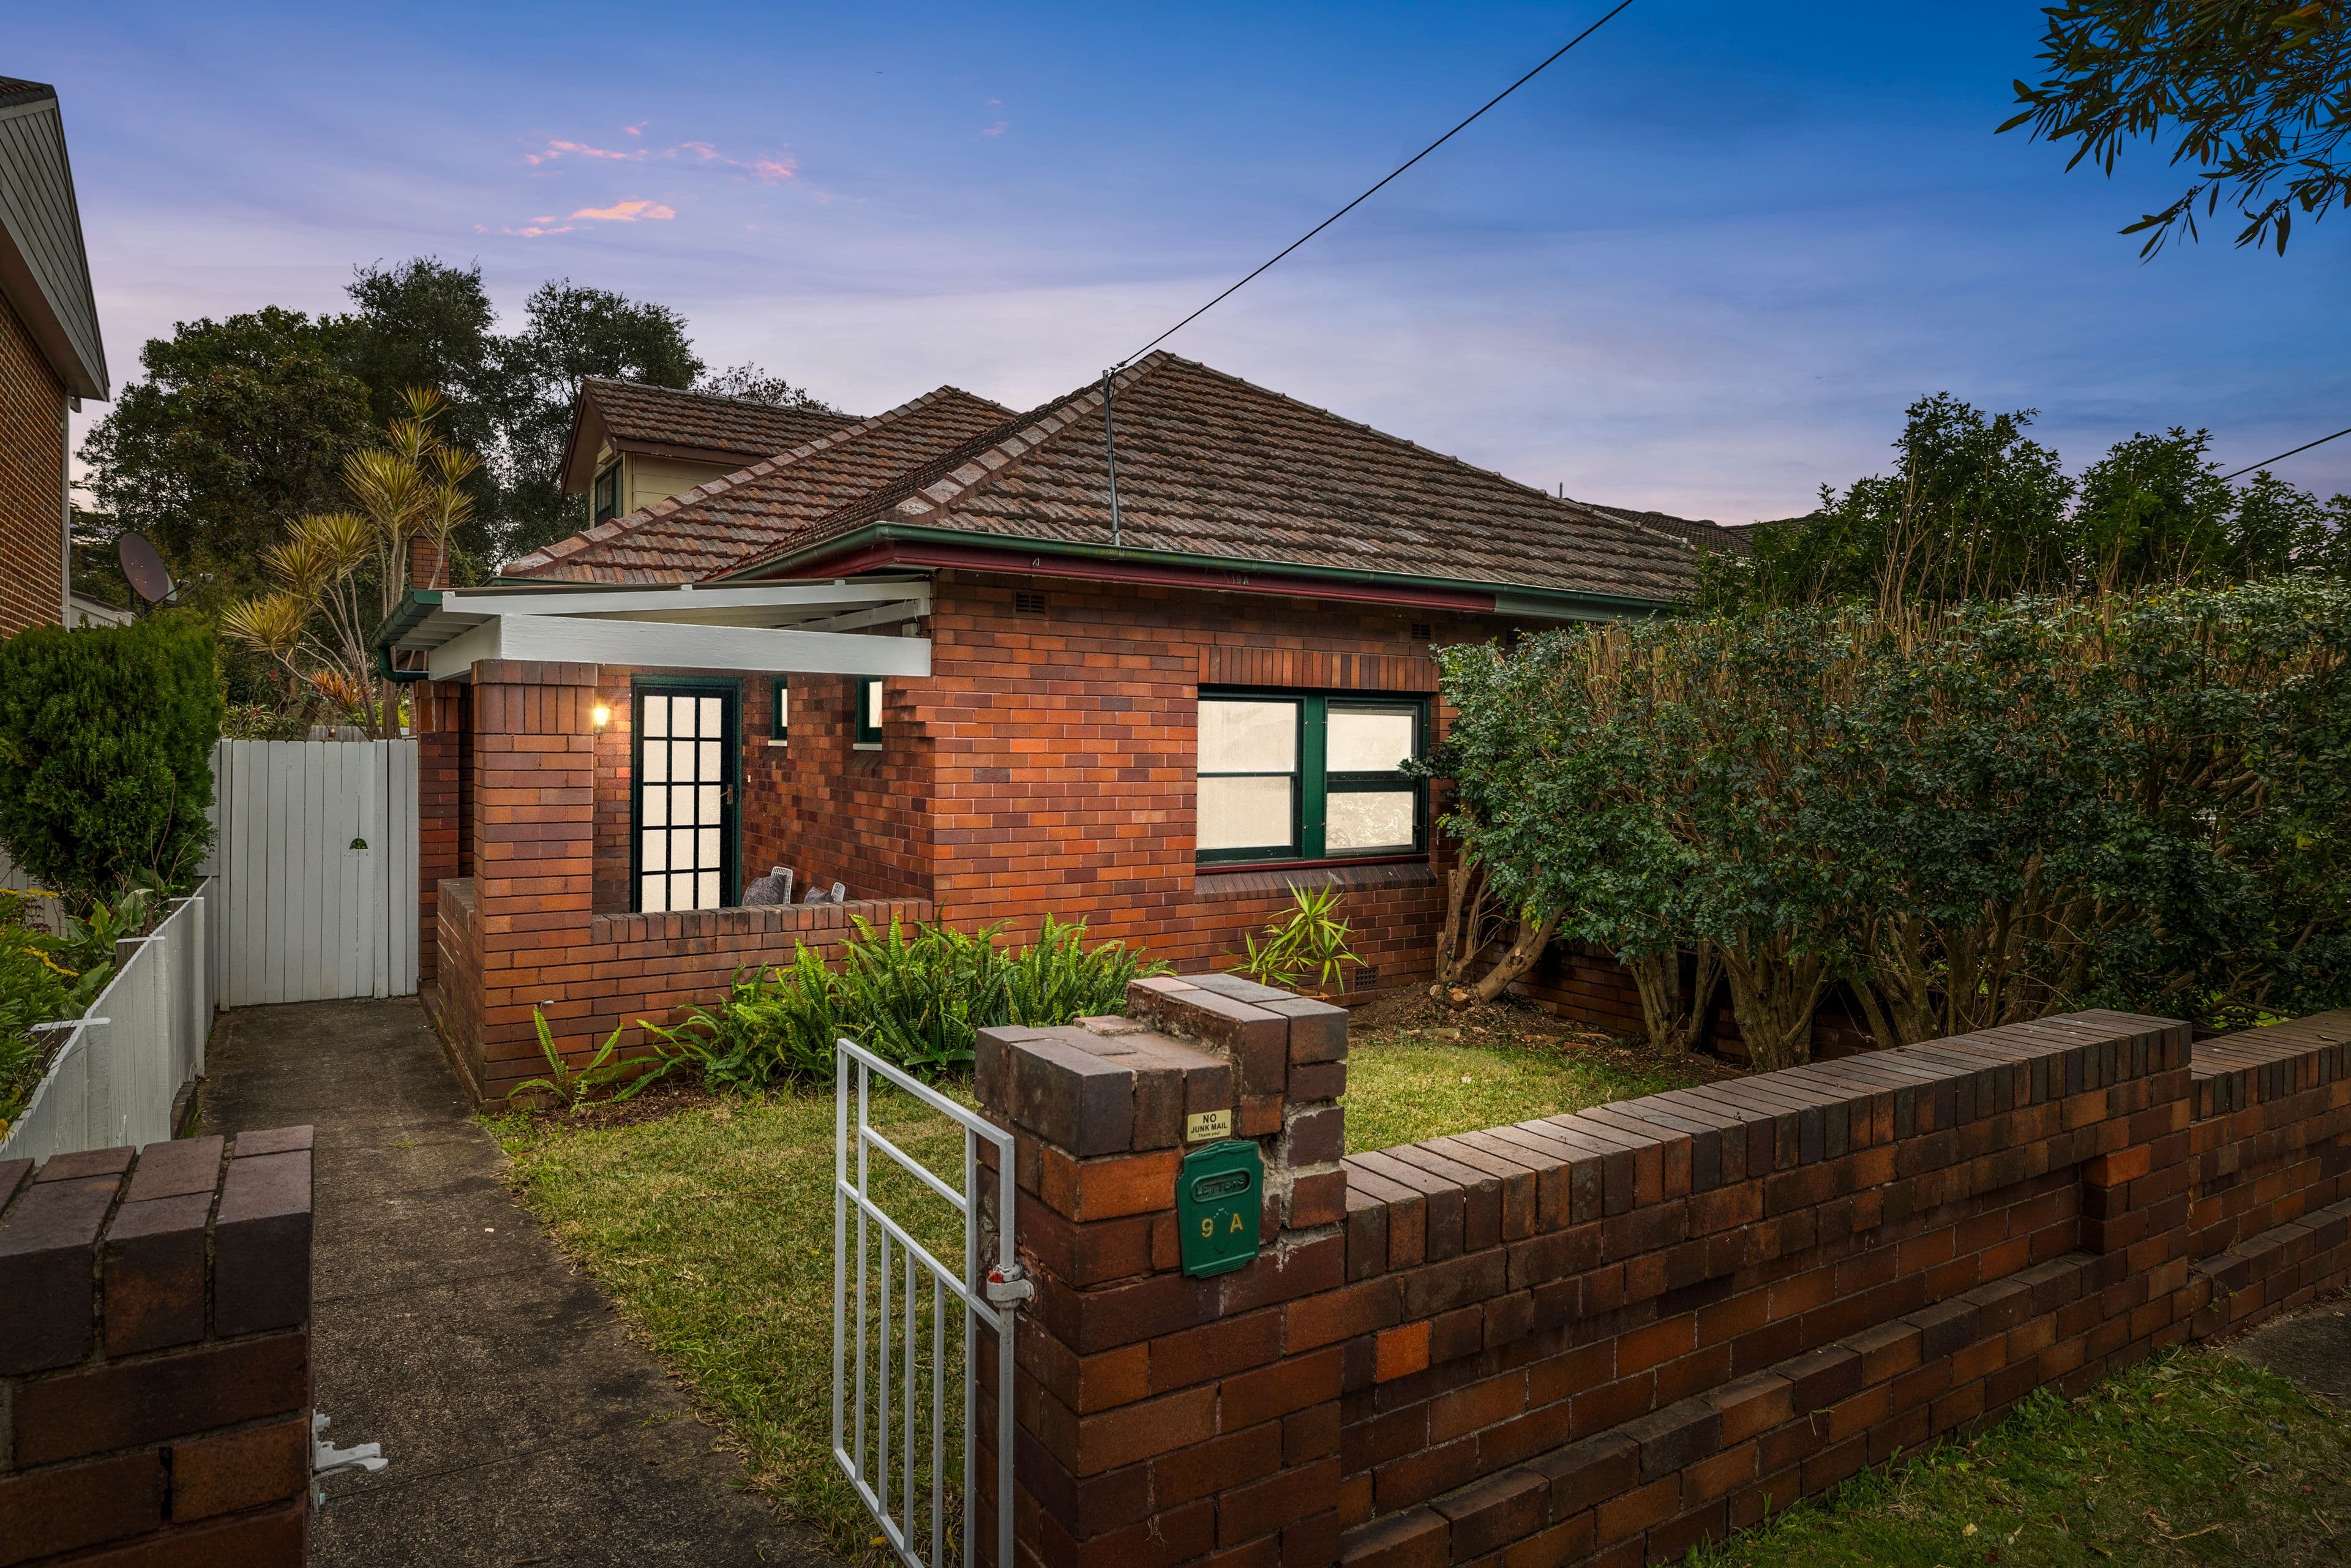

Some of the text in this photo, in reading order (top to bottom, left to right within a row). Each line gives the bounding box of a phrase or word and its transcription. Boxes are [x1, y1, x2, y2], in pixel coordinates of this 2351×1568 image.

[1203, 1114, 1217, 1123] NO
[1191, 1122, 1228, 1133] JUNK MAIL
[1195, 1176, 1244, 1197] LETTERS
[1201, 1213, 1243, 1238] 9 A
